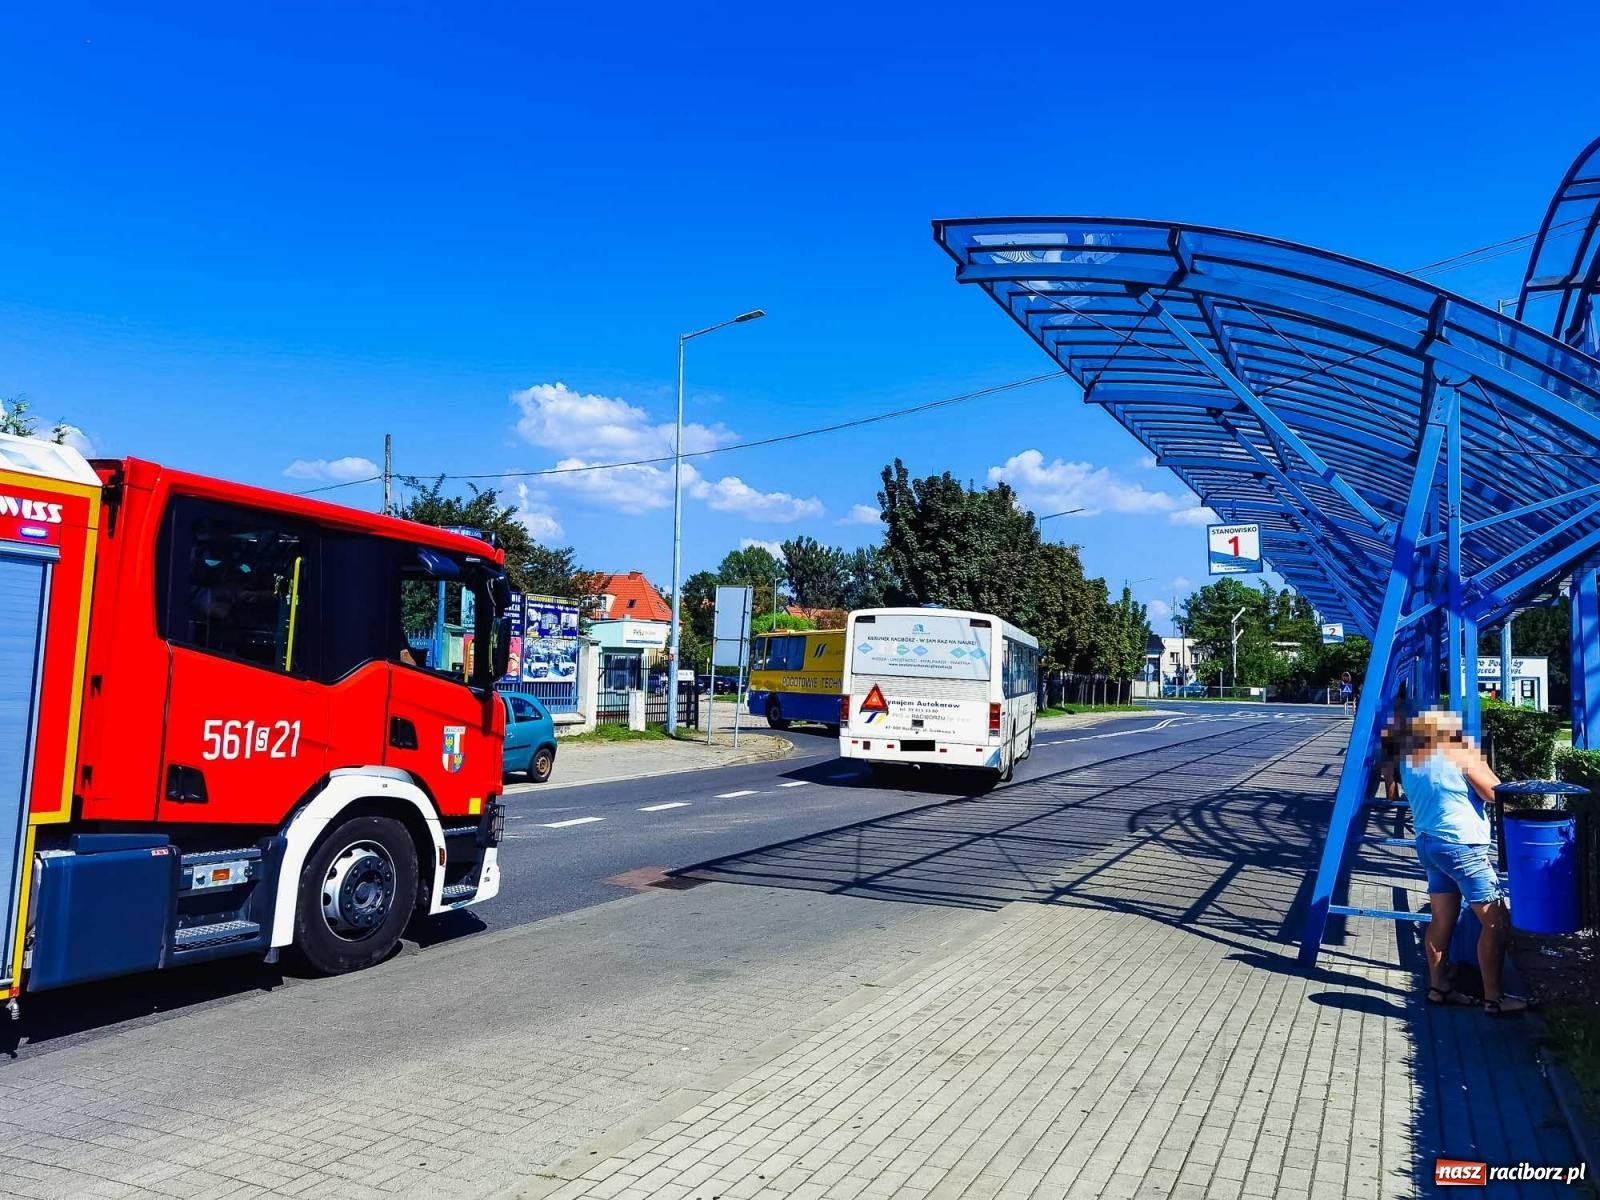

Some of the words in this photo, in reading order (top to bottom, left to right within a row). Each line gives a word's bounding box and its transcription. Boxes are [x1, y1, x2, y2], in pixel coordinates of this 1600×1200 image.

[1211, 526, 1257, 535] STANOWISKO
[1228, 536, 1239, 557] 1
[1329, 627, 1337, 637] 2
[885, 699, 914, 707] ynajem
[270, 720, 300, 758] 21
